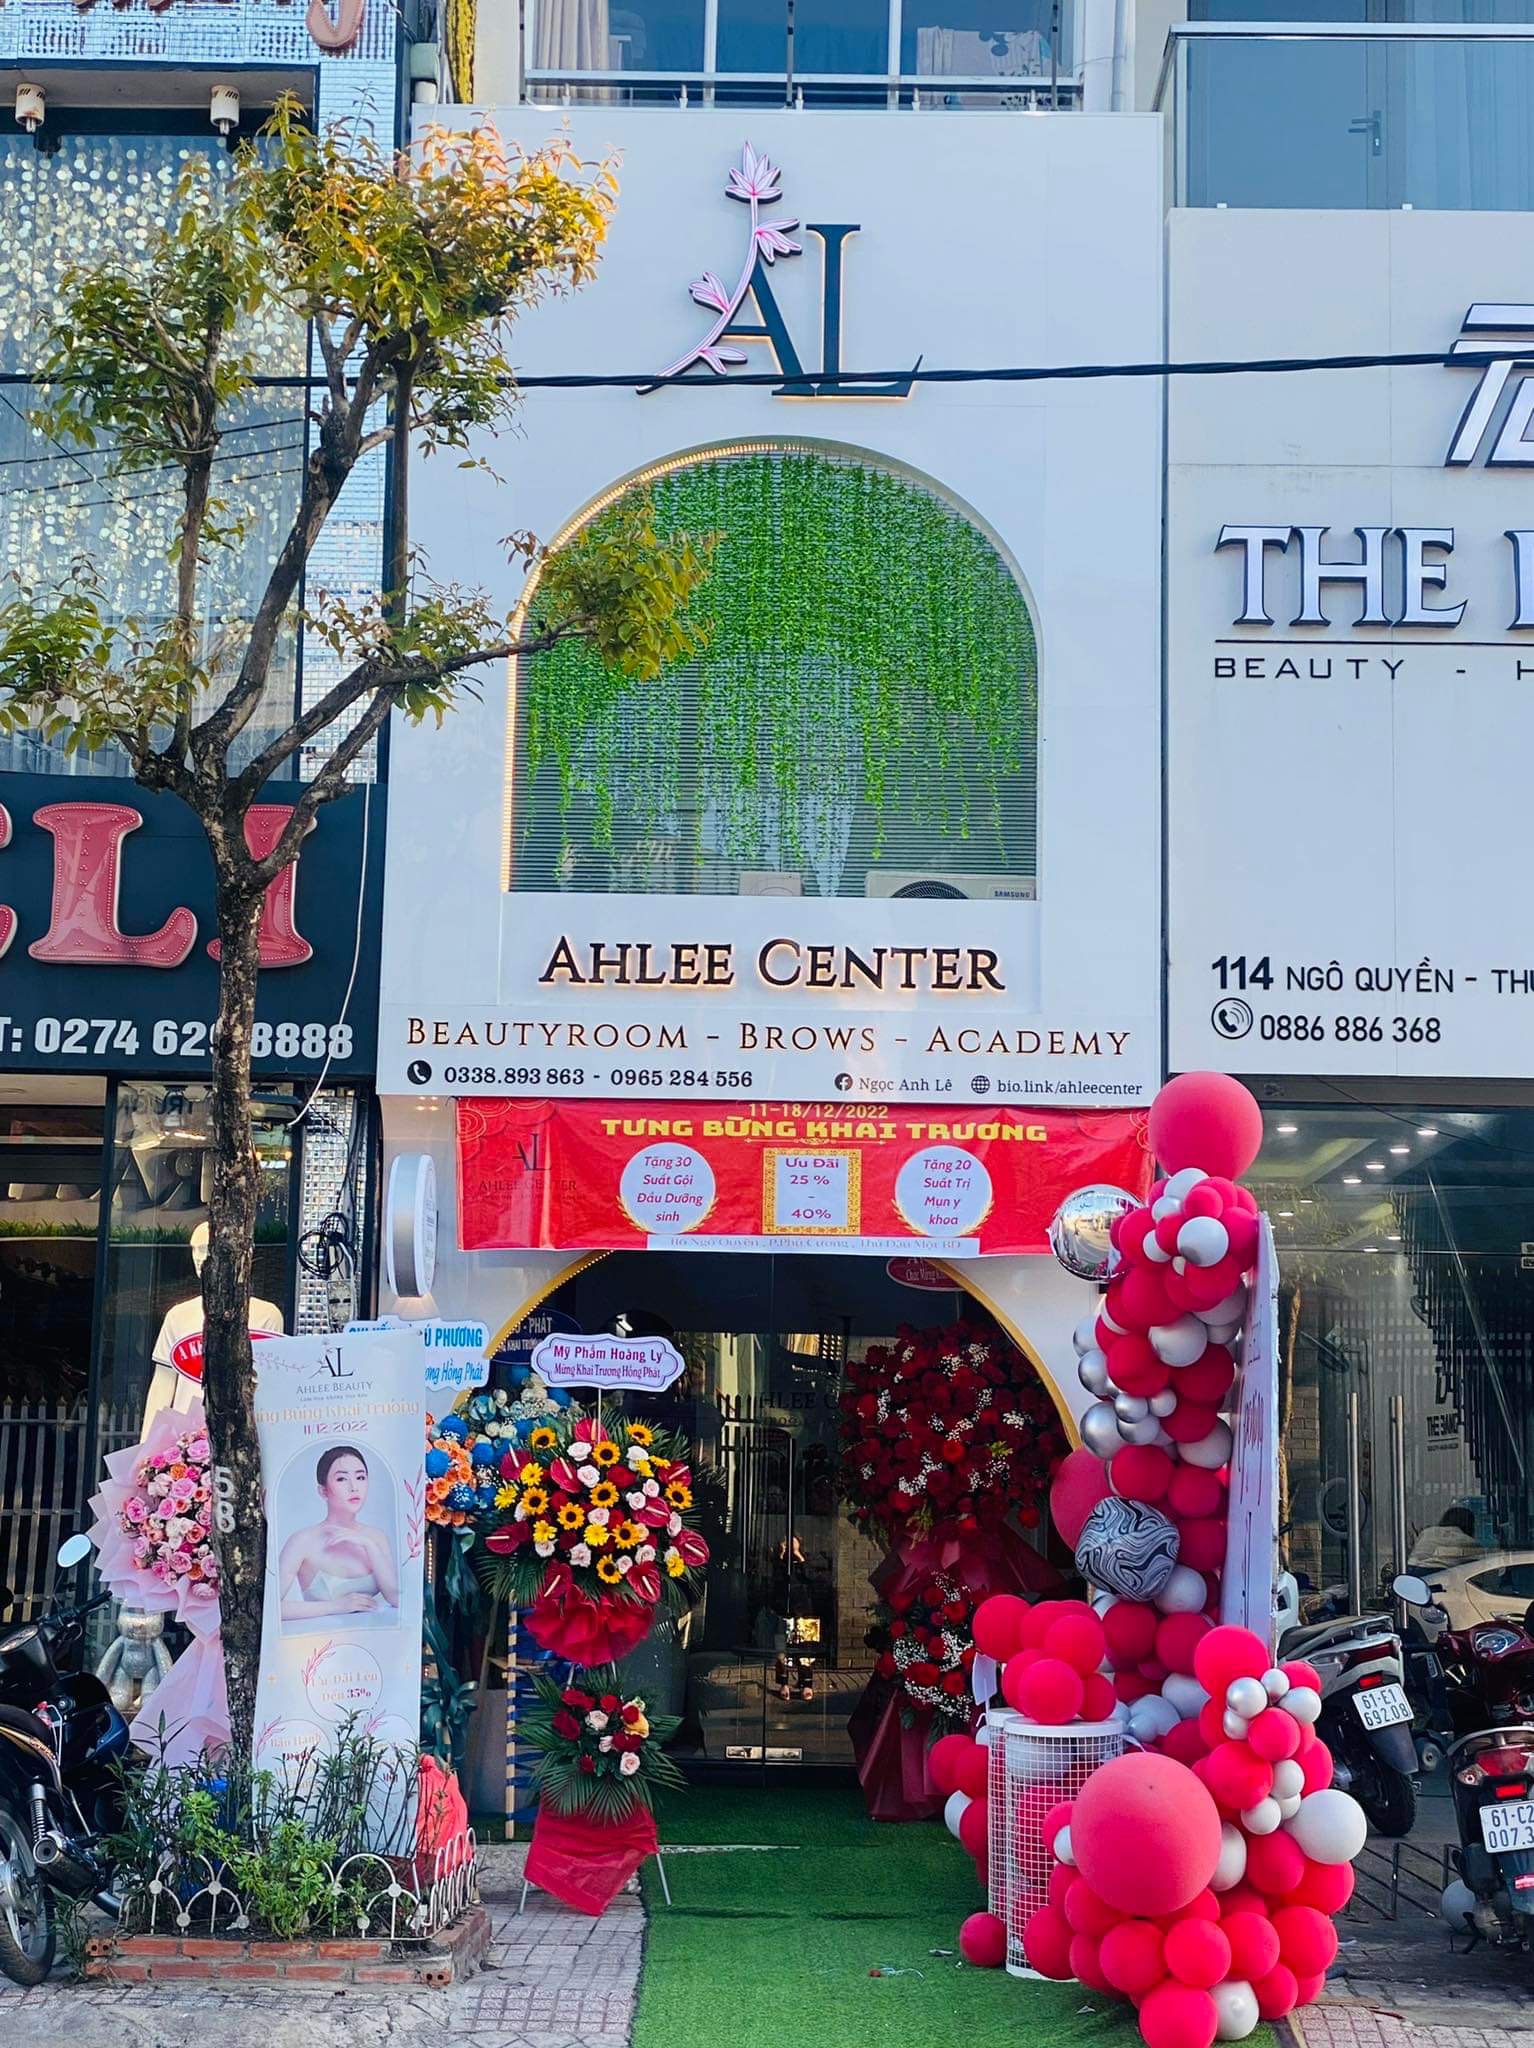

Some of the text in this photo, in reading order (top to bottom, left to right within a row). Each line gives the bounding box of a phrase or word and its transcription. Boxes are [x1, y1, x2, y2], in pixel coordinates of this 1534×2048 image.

[1215, 525, 1468, 628] THE
[1215, 658, 1404, 679] BEAUTY
[995, 890, 1030, 898] SAMSUNG
[1212, 955, 1274, 990] 114
[1286, 960, 1343, 991] NGÔ
[1356, 957, 1453, 993] QUYỀN
[1491, 969, 1534, 994] TH
[1260, 1014, 1441, 1043] 0886 886 368
[34, 1017, 139, 1054] 0274
[152, 1020, 217, 1056] 62
[444, 1066, 541, 1085] 0338.893
[546, 1068, 585, 1085] 863
[611, 1069, 663, 1086] 0965
[669, 1069, 709, 1086] 284
[716, 1071, 752, 1087] 556
[859, 1078, 952, 1092] Ngọc Anh Lê
[998, 1080, 1142, 1095] bio.link/ahleecenter
[750, 1103, 888, 1119] 11-18/12/2022
[601, 1118, 693, 1137] TƯNG
[806, 1121, 896, 1138] KHAI
[906, 1122, 1047, 1141] TRƯƠNG
[676, 1157, 692, 1167] 30
[786, 1157, 839, 1168] Ưu Đãi
[955, 1160, 971, 1170] 20
[790, 1175, 809, 1184] 25
[656, 1211, 680, 1222] sinh
[792, 1209, 831, 1219] 40%
[929, 1214, 958, 1225] khoa
[435, 1327, 482, 1347] PHƯƠNG
[554, 1345, 569, 1360] Mỹ
[611, 1348, 646, 1362] Hoàng
[576, 1364, 593, 1375] Khai
[297, 1381, 373, 1395] AHLEE BEAUTY
[1364, 1702, 1409, 1727] 692.08
